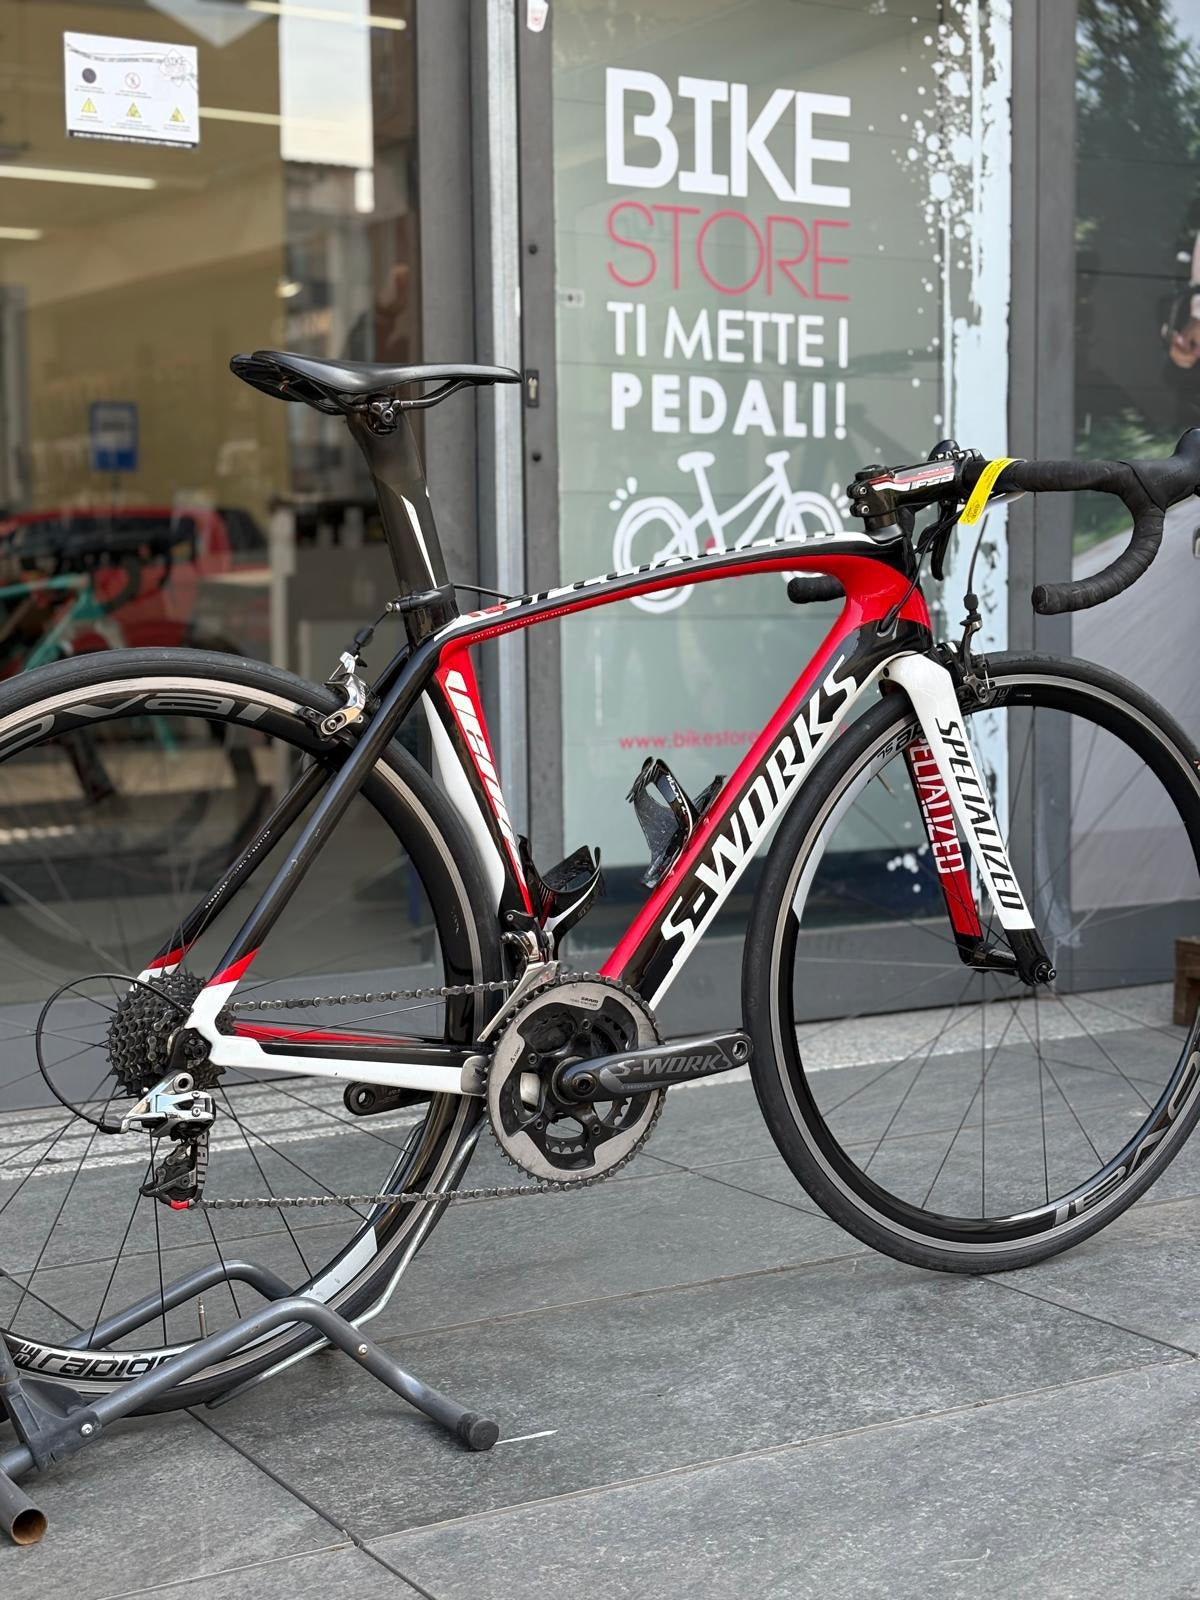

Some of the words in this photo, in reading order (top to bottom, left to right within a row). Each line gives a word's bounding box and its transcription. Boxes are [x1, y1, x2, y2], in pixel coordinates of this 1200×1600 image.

[606, 67, 850, 208] BIKE
[607, 200, 851, 302] STORE
[607, 301, 647, 357] TI
[664, 305, 825, 367] METTE
[839, 317, 849, 368] I
[611, 371, 847, 440] PEDALI!
[661, 654, 857, 964] S-WORKS
[934, 716, 1025, 911] SPECIALIZED
[615, 1054, 733, 1076] S-WORKS
[38, 1351, 180, 1377] rapid
